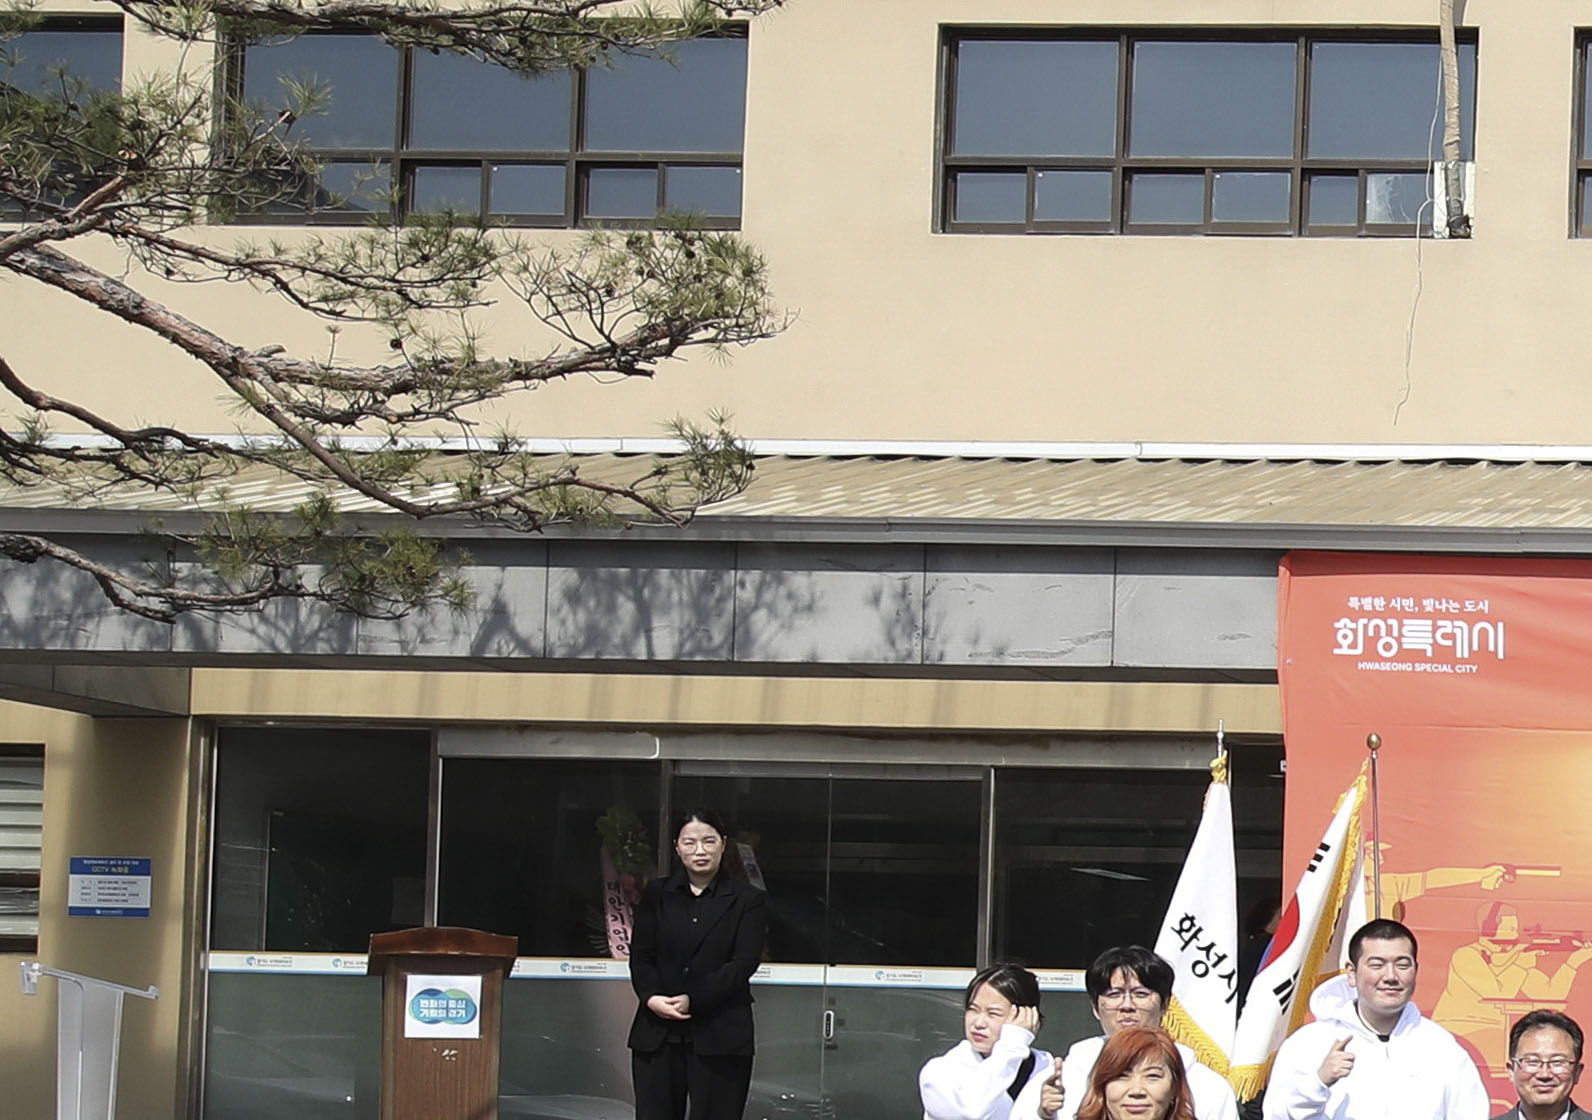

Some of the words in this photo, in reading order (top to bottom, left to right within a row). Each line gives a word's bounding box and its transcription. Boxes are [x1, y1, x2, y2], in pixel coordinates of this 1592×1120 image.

[1347, 596, 1386, 612] 특별한
[1389, 596, 1419, 613] 시민,
[1422, 597, 1461, 613] 빛나는
[1463, 599, 1489, 614] 도시
[1332, 617, 1505, 660] 화성특례시
[1357, 661, 1413, 672] HWASEONG
[1414, 662, 1454, 673] SPECIAL
[1455, 664, 1478, 673] CITY
[1170, 911, 1239, 1005] 화성시
